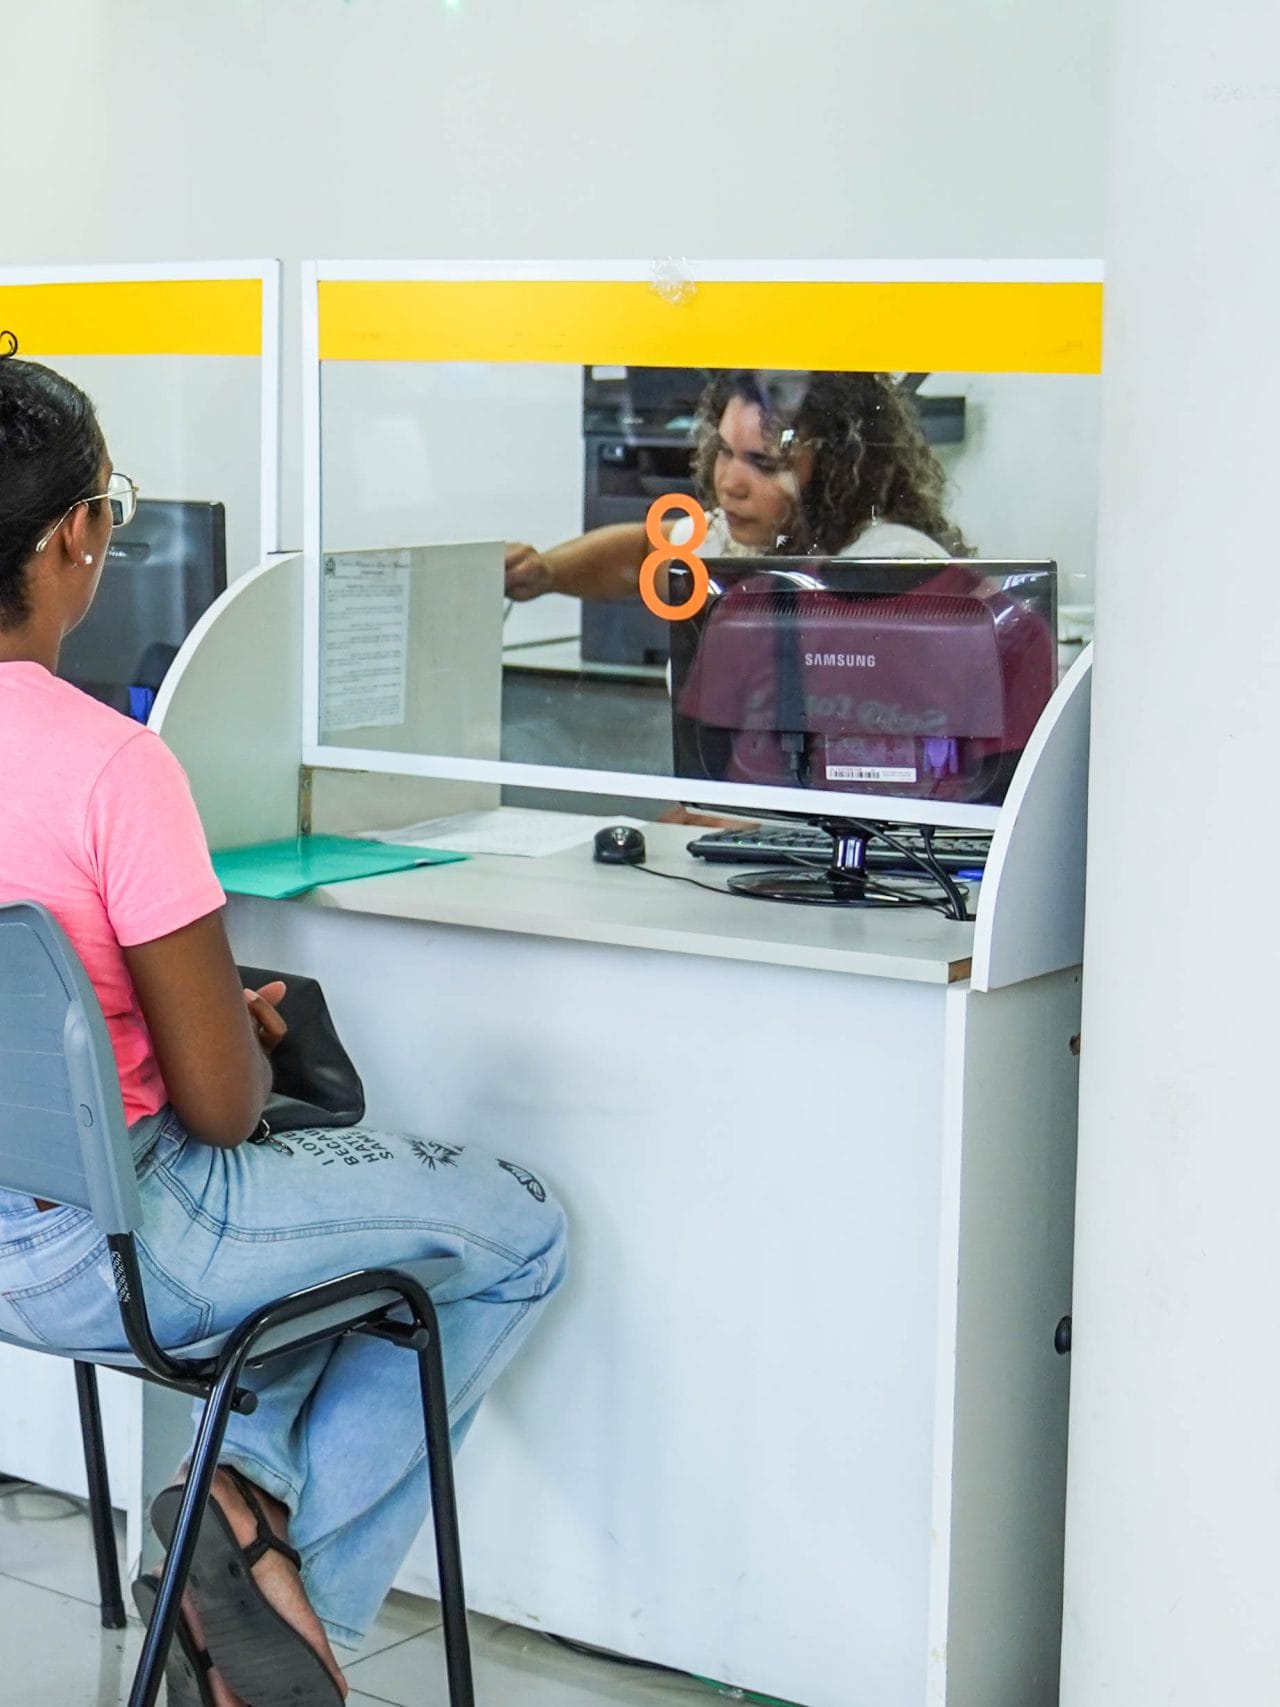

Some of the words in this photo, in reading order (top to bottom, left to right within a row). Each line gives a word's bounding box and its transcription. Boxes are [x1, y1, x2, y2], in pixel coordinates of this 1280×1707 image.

[638, 492, 709, 621] 8
[805, 653, 876, 668] SAMSUNG
[281, 1131, 325, 1157] LOVE
[304, 1129, 360, 1166] BECAU
[336, 1134, 380, 1163] HATE
